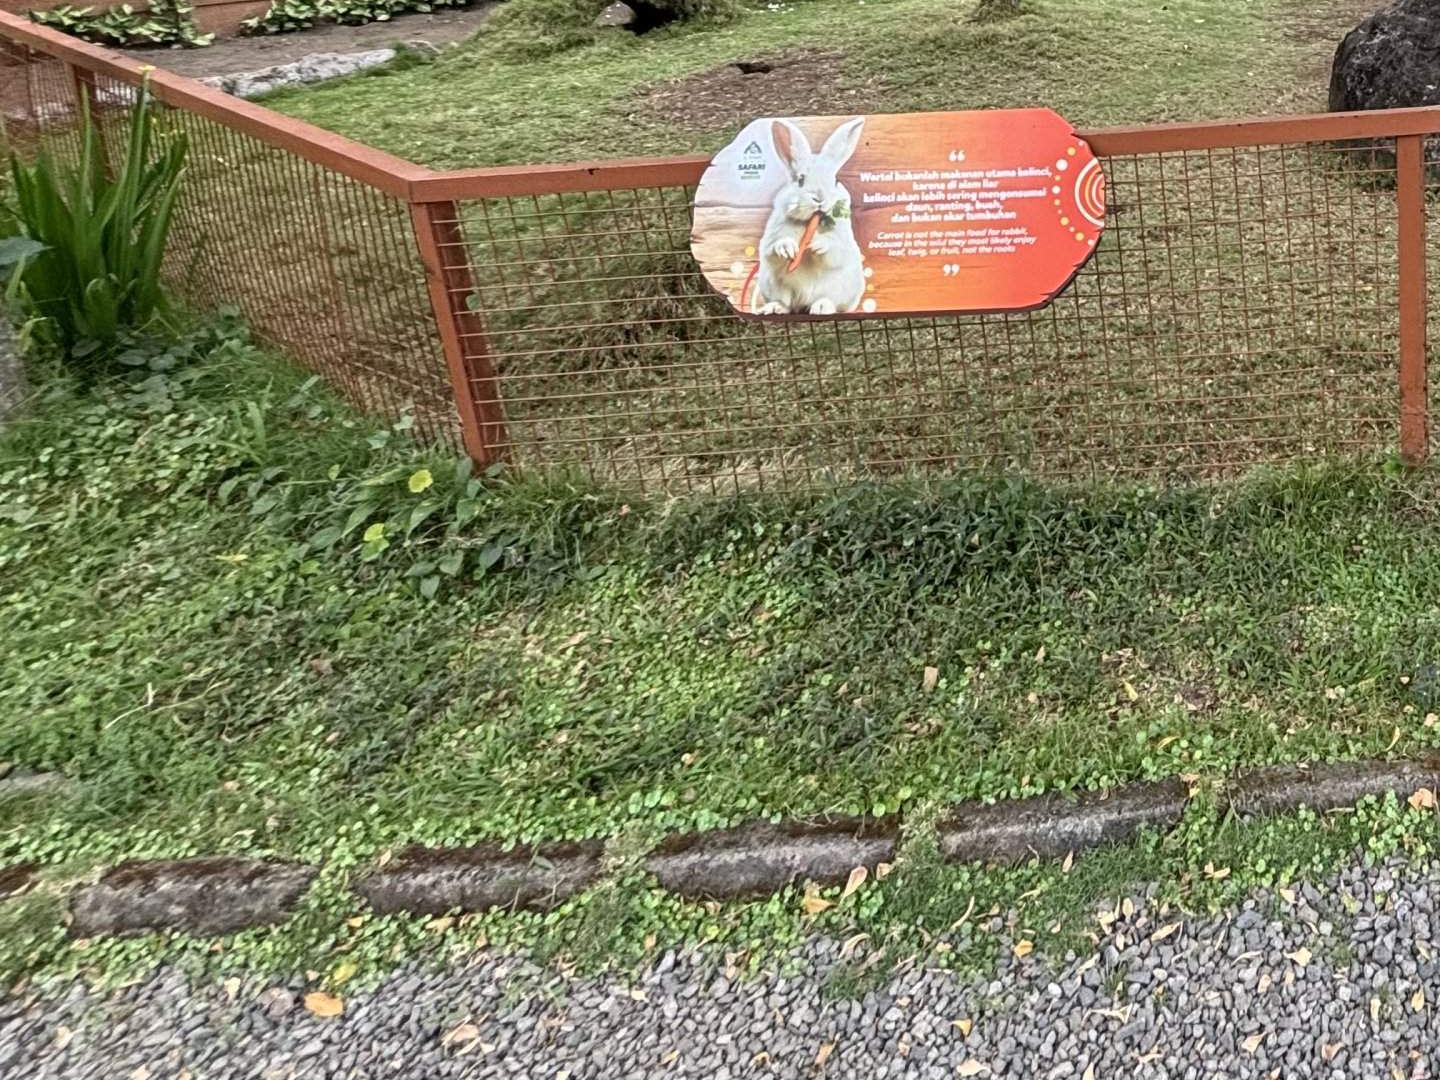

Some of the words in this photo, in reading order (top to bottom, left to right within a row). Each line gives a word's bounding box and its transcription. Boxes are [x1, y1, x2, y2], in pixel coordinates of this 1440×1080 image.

[895, 170, 939, 181] bukanlah
[940, 169, 984, 180] makanan
[985, 170, 1016, 178] utama
[1018, 167, 1052, 177] kelinci,
[912, 182, 945, 190] karena
[946, 180, 956, 189] di
[958, 180, 981, 188] alam
[983, 179, 999, 188] liar
[864, 192, 895, 202] kelinci
[896, 192, 920, 201] akan
[921, 191, 945, 200] lebih
[946, 190, 977, 201] sering
[979, 187, 1046, 200] mengonsumsi
[905, 202, 934, 213] daun,
[935, 201, 974, 212] ranting,
[976, 200, 1003, 210] buah,
[891, 213, 910, 222] dan
[911, 212, 942, 222] bukan
[943, 211, 965, 221] akar
[966, 210, 1016, 220] tumbuhan
[878, 231, 904, 239] Carrot
[930, 230, 943, 238] the
[944, 229, 965, 237] main
[868, 240, 902, 248] because
[914, 239, 928, 247] the
[948, 238, 966, 248] they
[990, 236, 1012, 245] likely
[1013, 236, 1037, 245] enjoy
[962, 246, 978, 254] not
[993, 245, 1016, 253] roots
